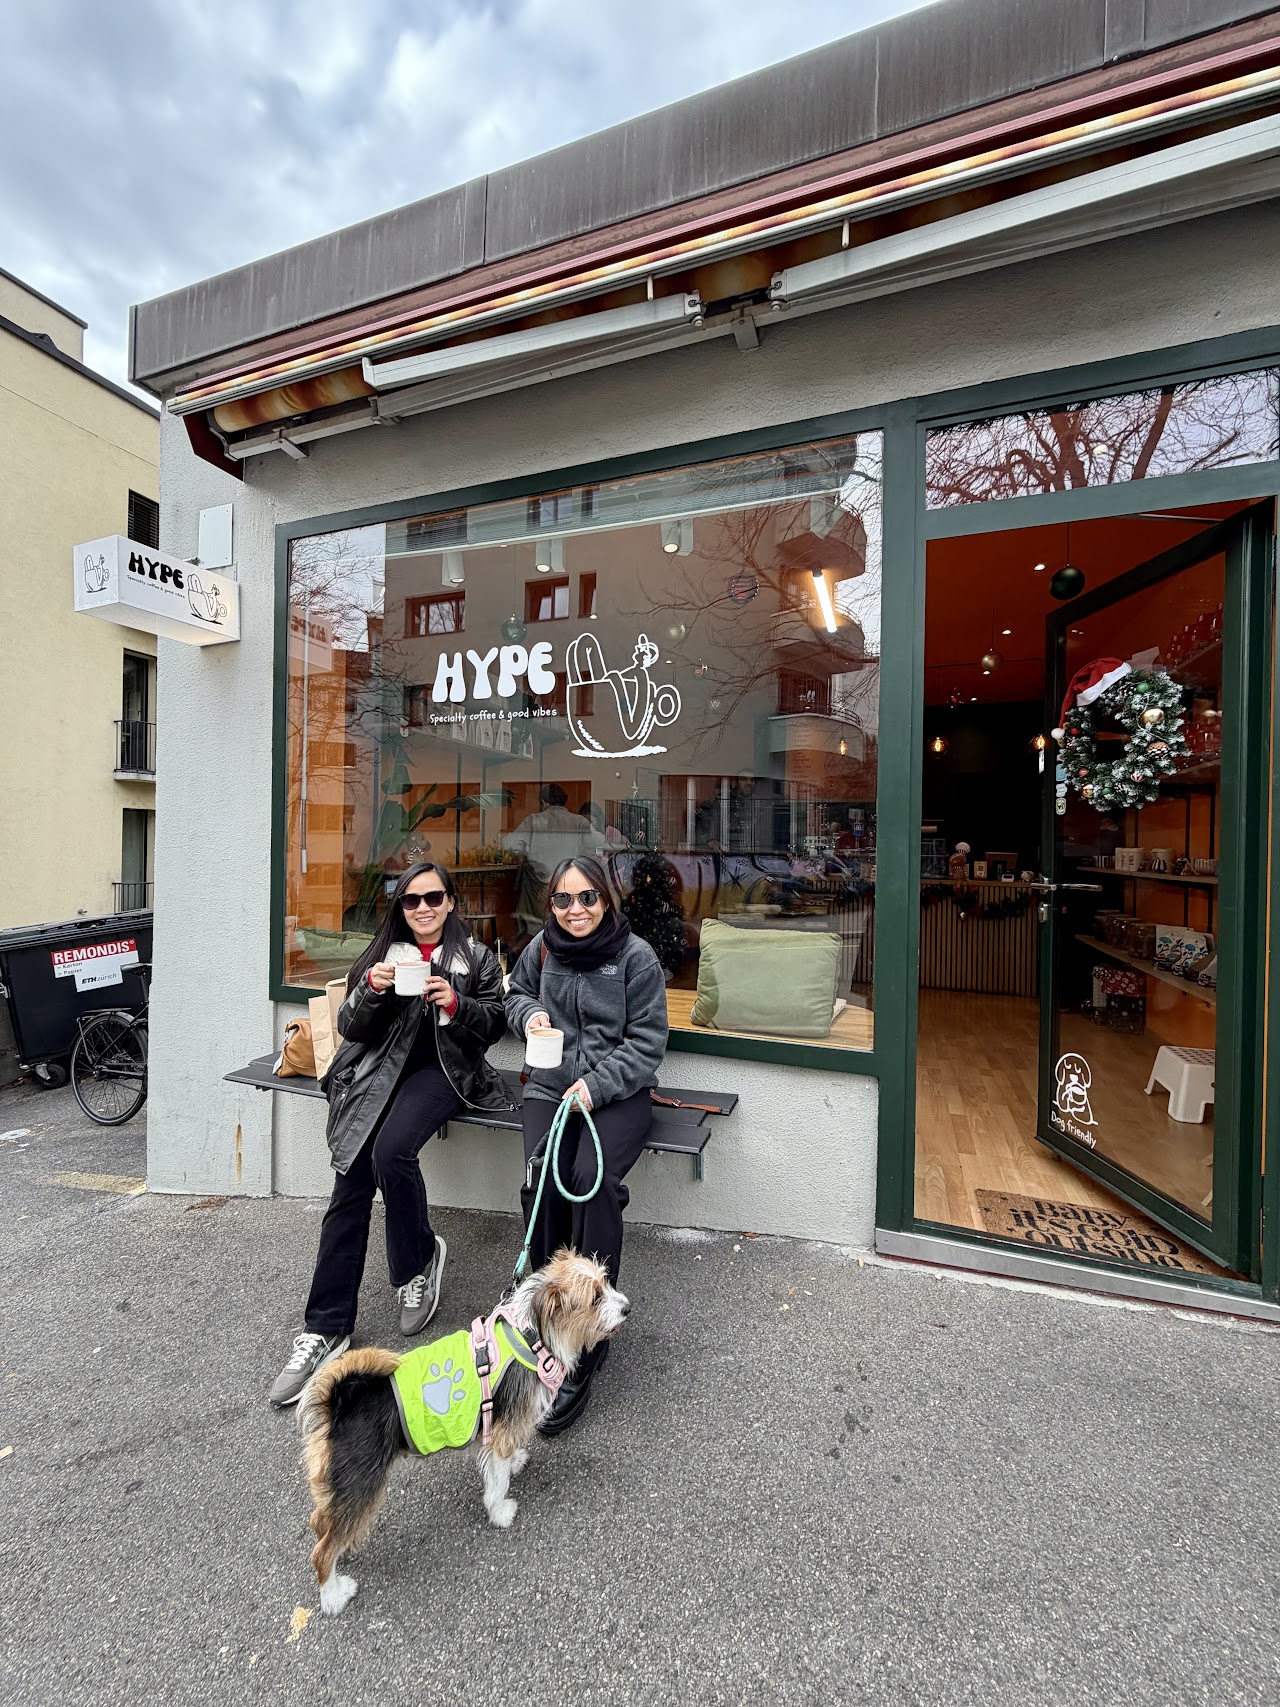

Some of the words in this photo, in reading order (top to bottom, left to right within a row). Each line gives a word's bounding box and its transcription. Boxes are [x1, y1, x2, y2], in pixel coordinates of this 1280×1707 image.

[128, 551, 184, 589] HYPE
[432, 642, 556, 703] HYPE
[429, 712, 466, 726] Specialty
[469, 710, 496, 720] coffee
[498, 709, 505, 720] &
[507, 707, 529, 722] good
[532, 706, 557, 717] vibes
[63, 968, 82, 976] Papier
[1051, 1110, 1066, 1132] Dog
[1066, 1120, 1097, 1149] friendly
